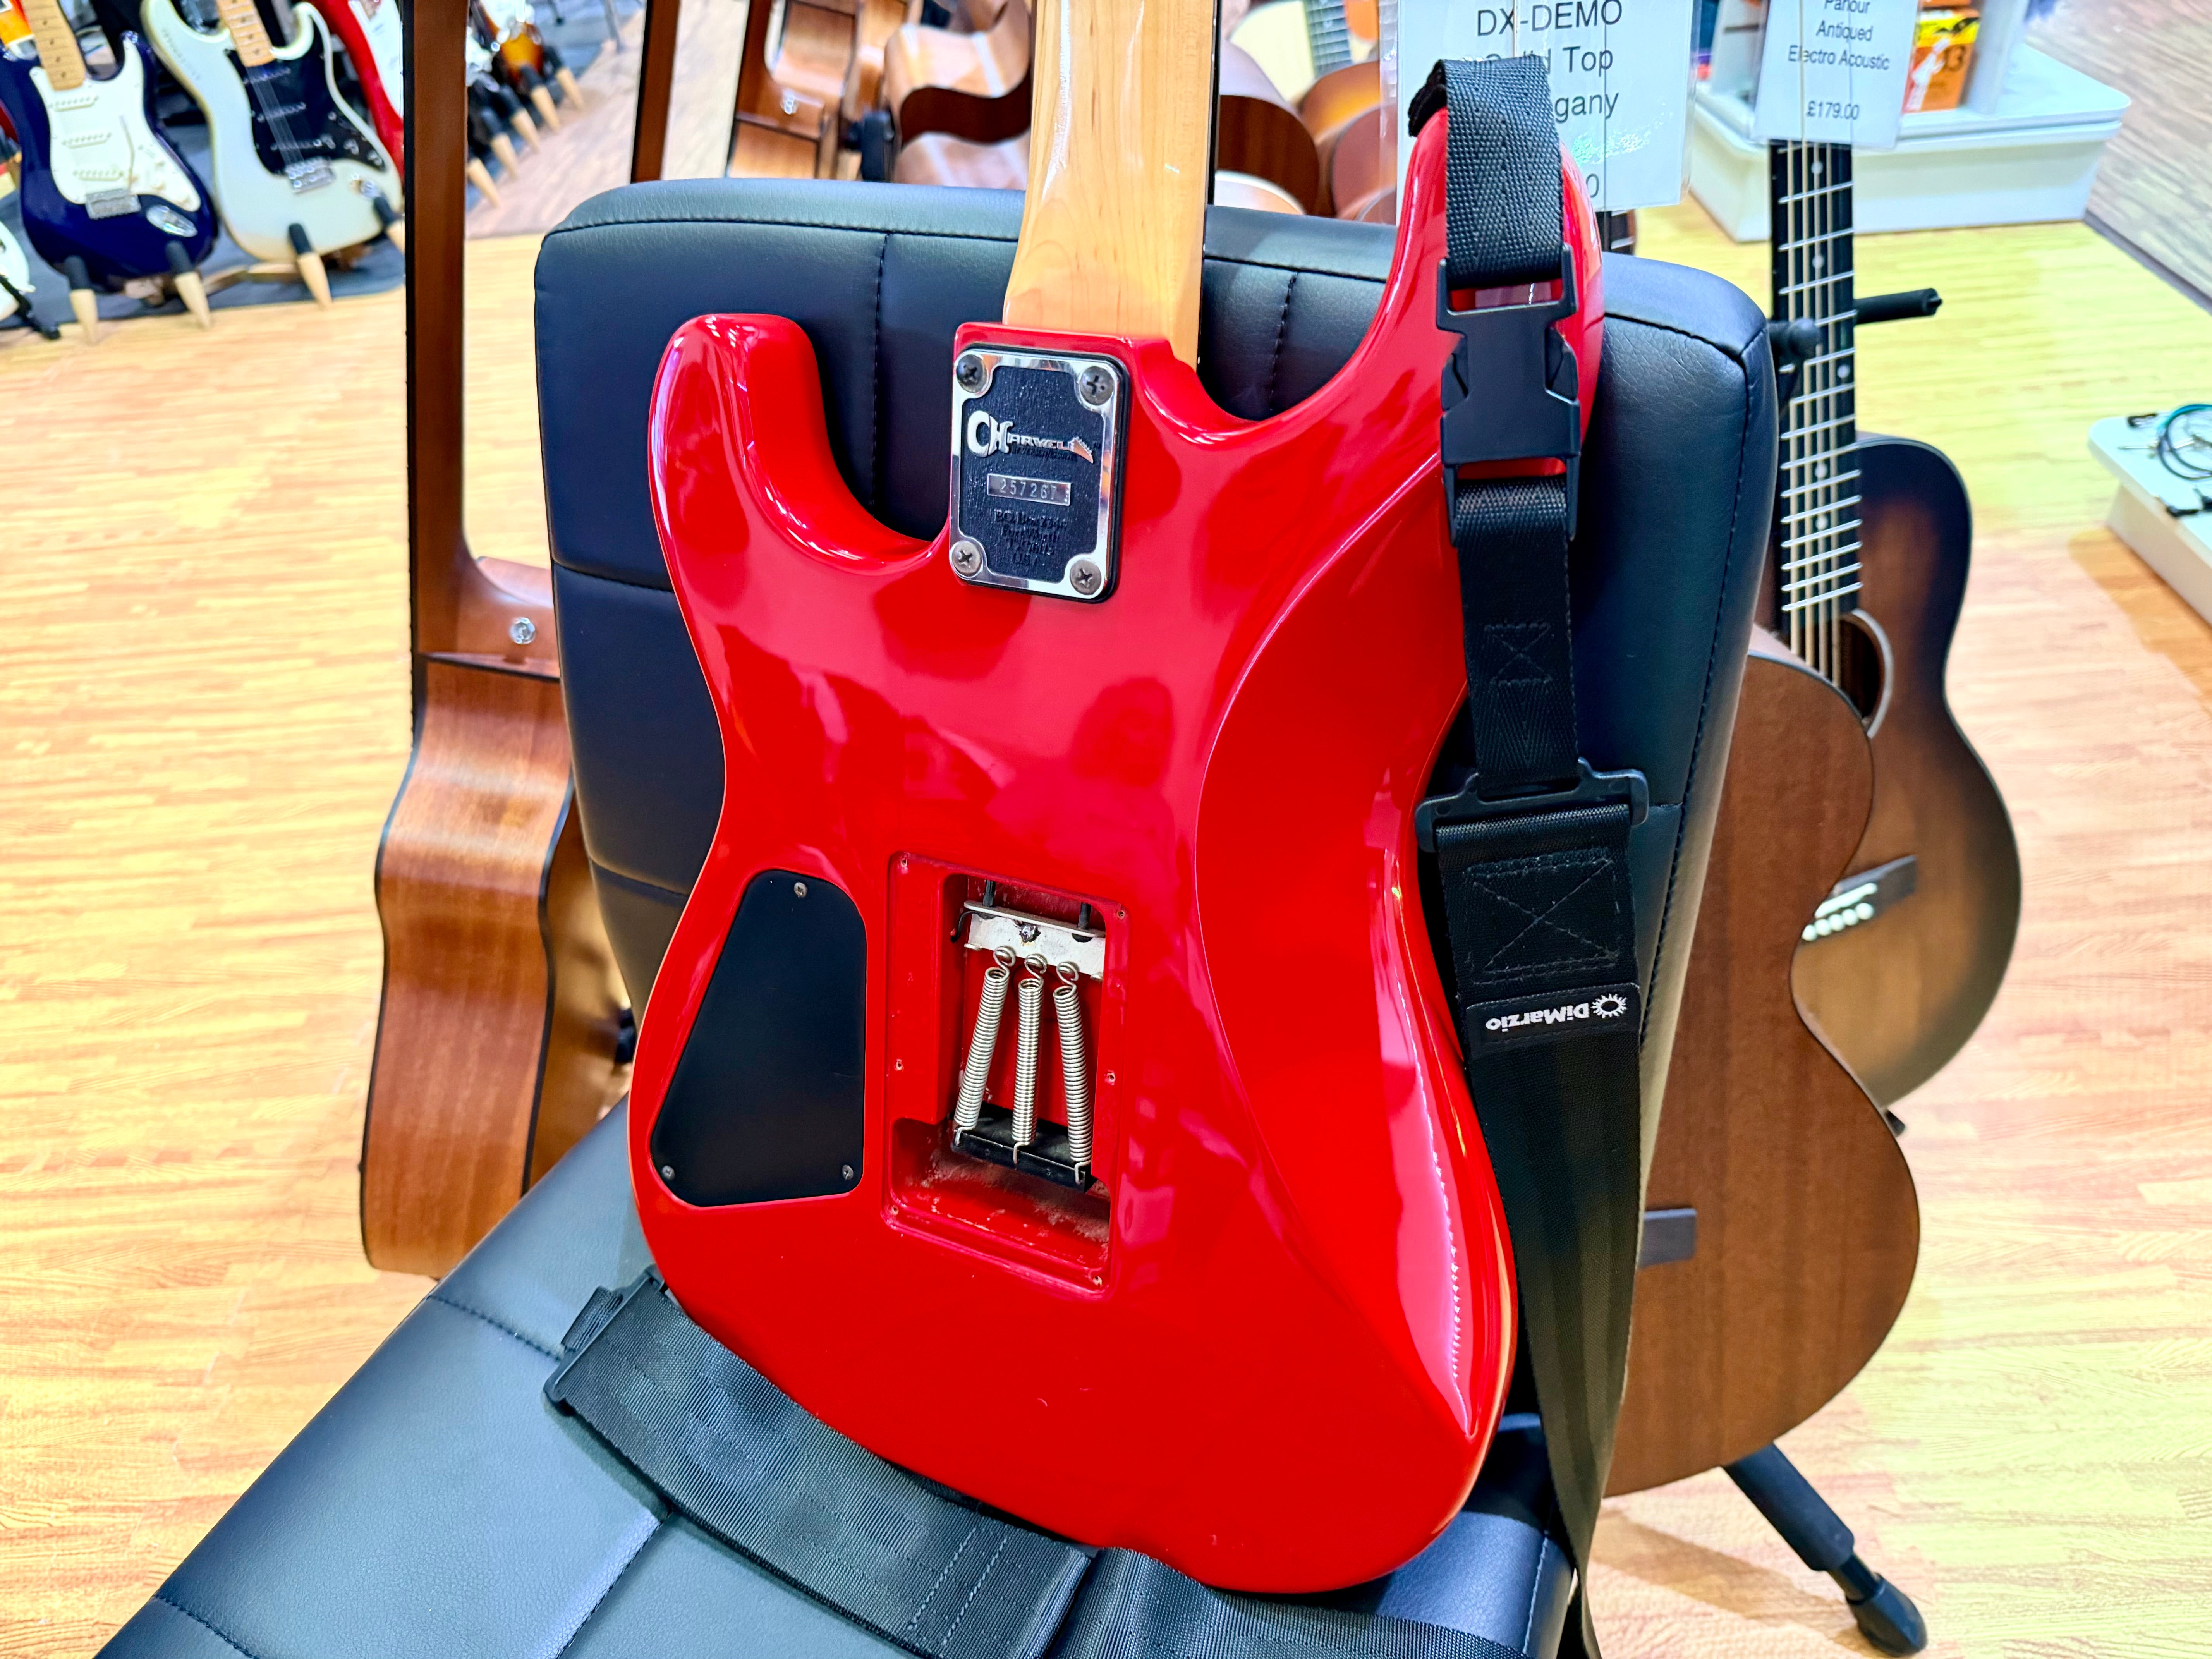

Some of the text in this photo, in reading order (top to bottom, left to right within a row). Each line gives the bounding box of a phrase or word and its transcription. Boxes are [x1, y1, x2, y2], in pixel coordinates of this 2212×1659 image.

[1477, 0, 1623, 36] DX-DEMO
[1815, 20, 1874, 42] Antiqued
[1562, 45, 1613, 77] Top
[1787, 45, 1890, 70] Electro Acoustic
[1554, 92, 1619, 124] gany
[1806, 100, 1860, 120] £179.00
[1486, 1003, 1589, 1032] DiMarzio
